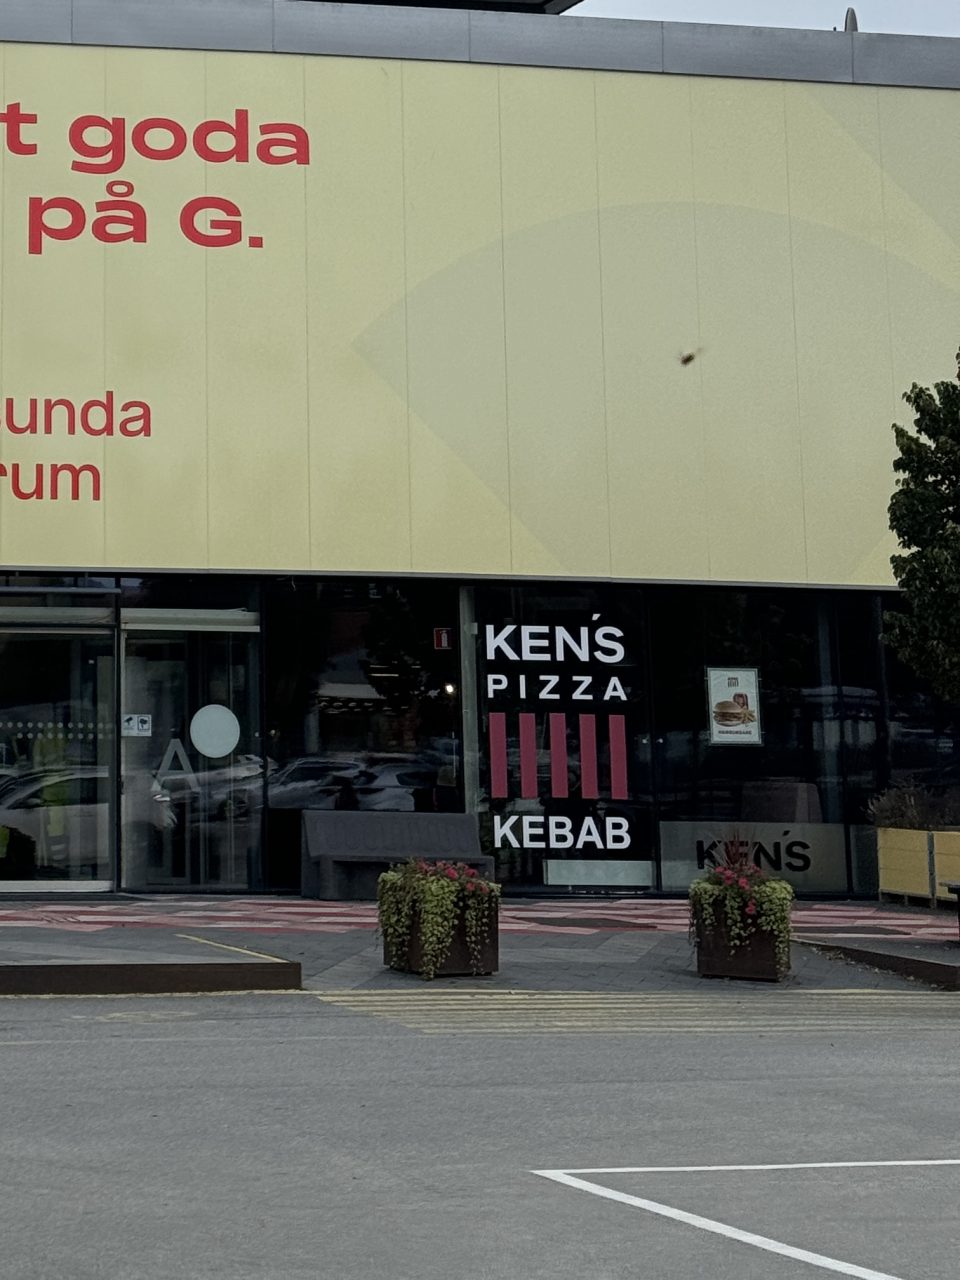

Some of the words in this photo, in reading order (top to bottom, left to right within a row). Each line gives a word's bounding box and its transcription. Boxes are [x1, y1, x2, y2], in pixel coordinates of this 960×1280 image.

[69, 109, 310, 175] goda
[28, 181, 147, 255] på
[179, 196, 264, 248] G.
[487, 674, 628, 701] PIZZA
[493, 815, 631, 850] KEBAB
